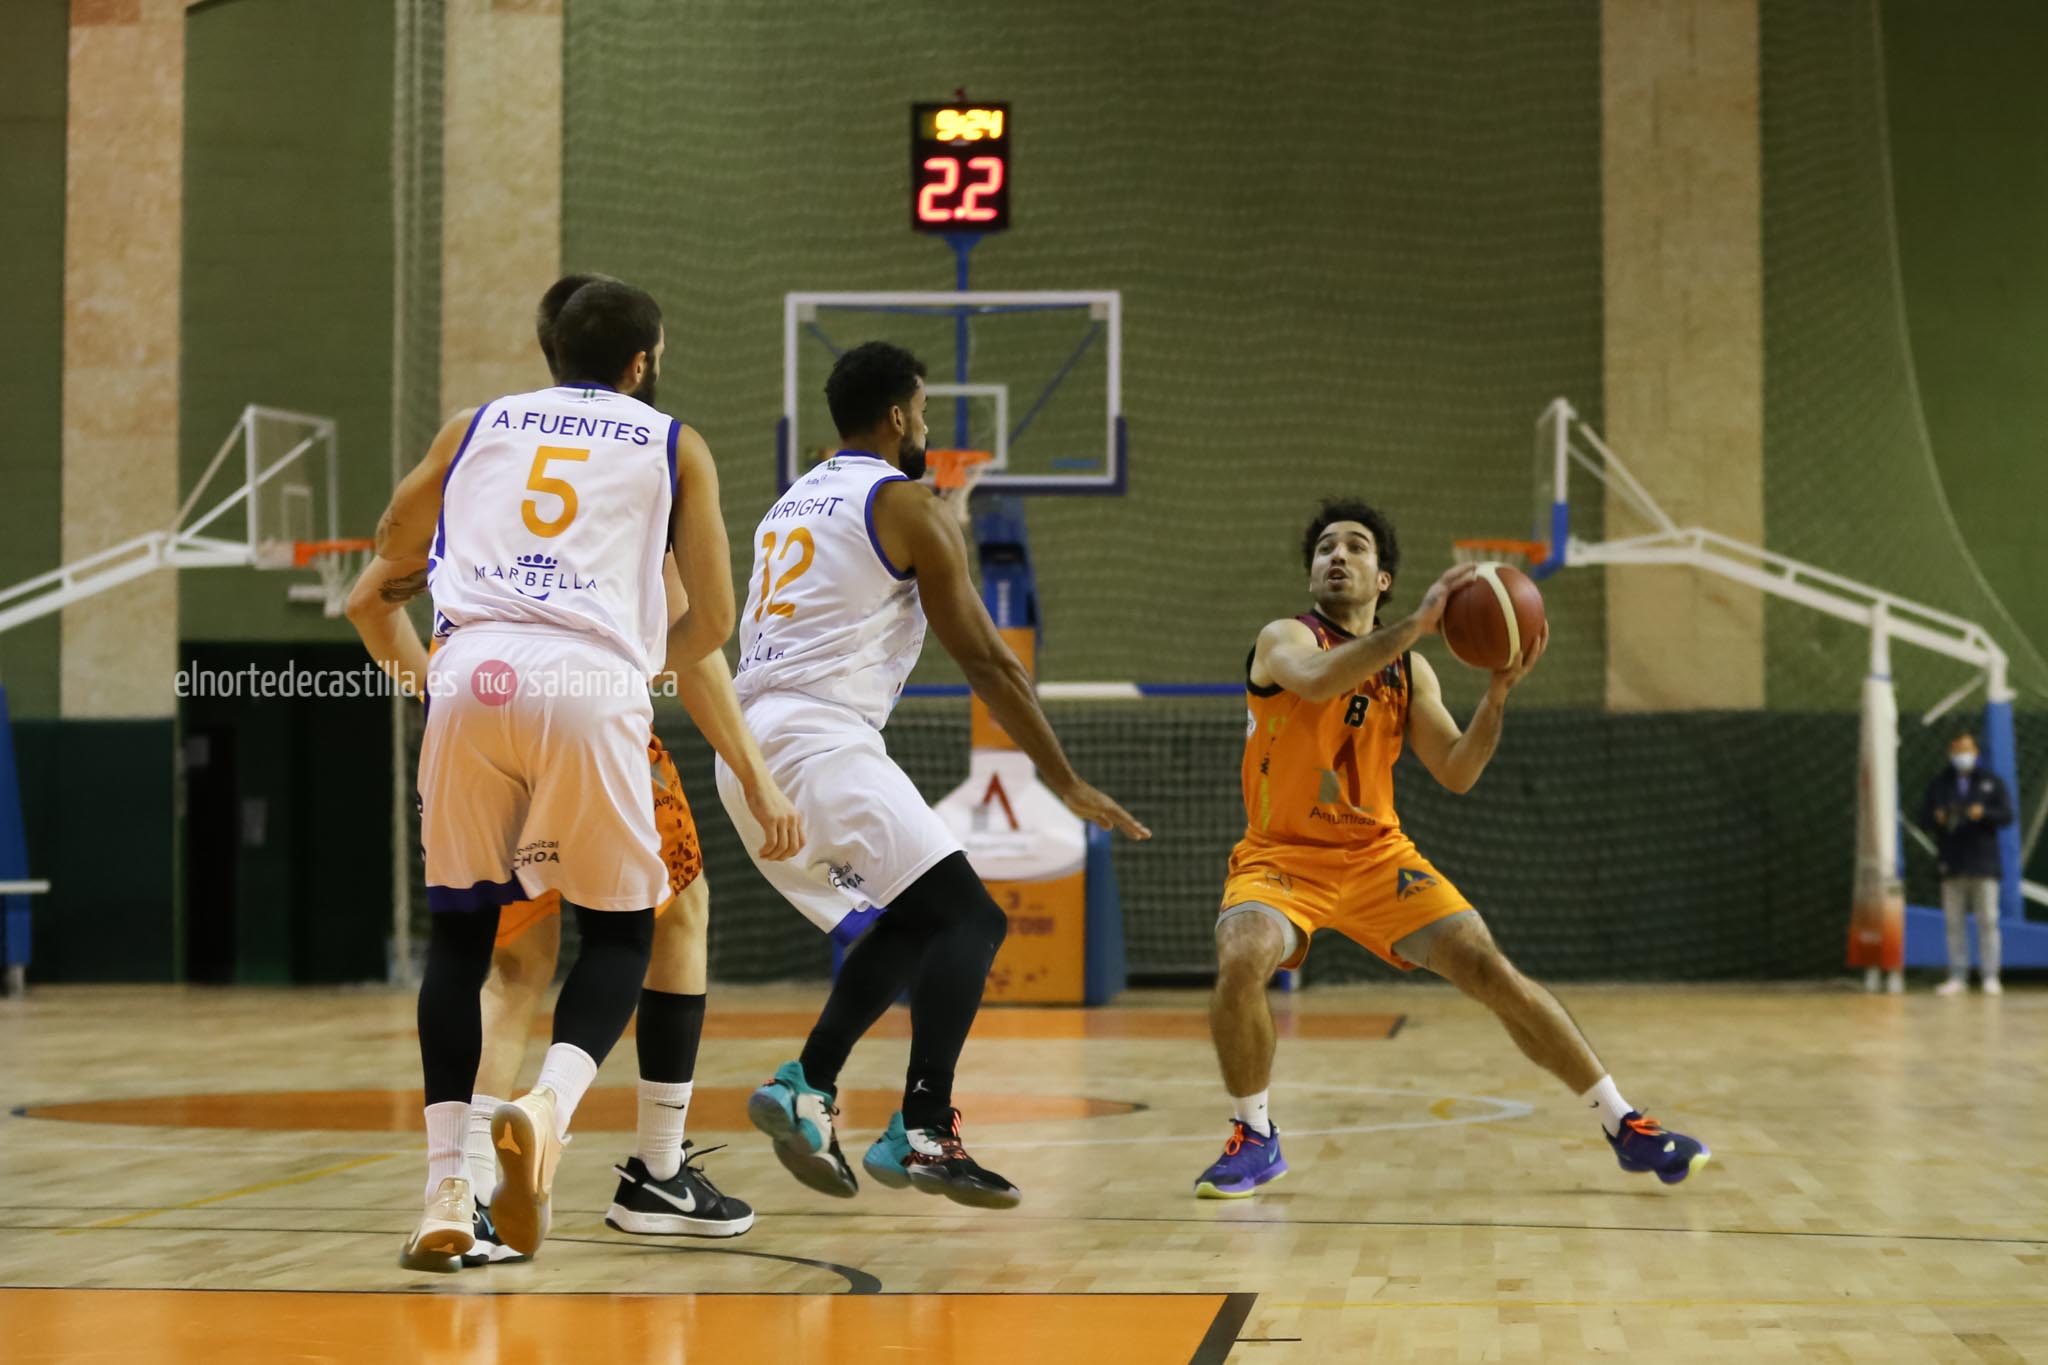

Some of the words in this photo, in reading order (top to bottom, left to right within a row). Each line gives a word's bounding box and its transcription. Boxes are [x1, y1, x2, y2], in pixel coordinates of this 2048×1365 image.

[918, 156, 1004, 222] 2.2
[521, 445, 591, 538] 5
[473, 565, 600, 592] MARBELLA
[754, 526, 815, 623] 12
[1344, 694, 1370, 728] 8
